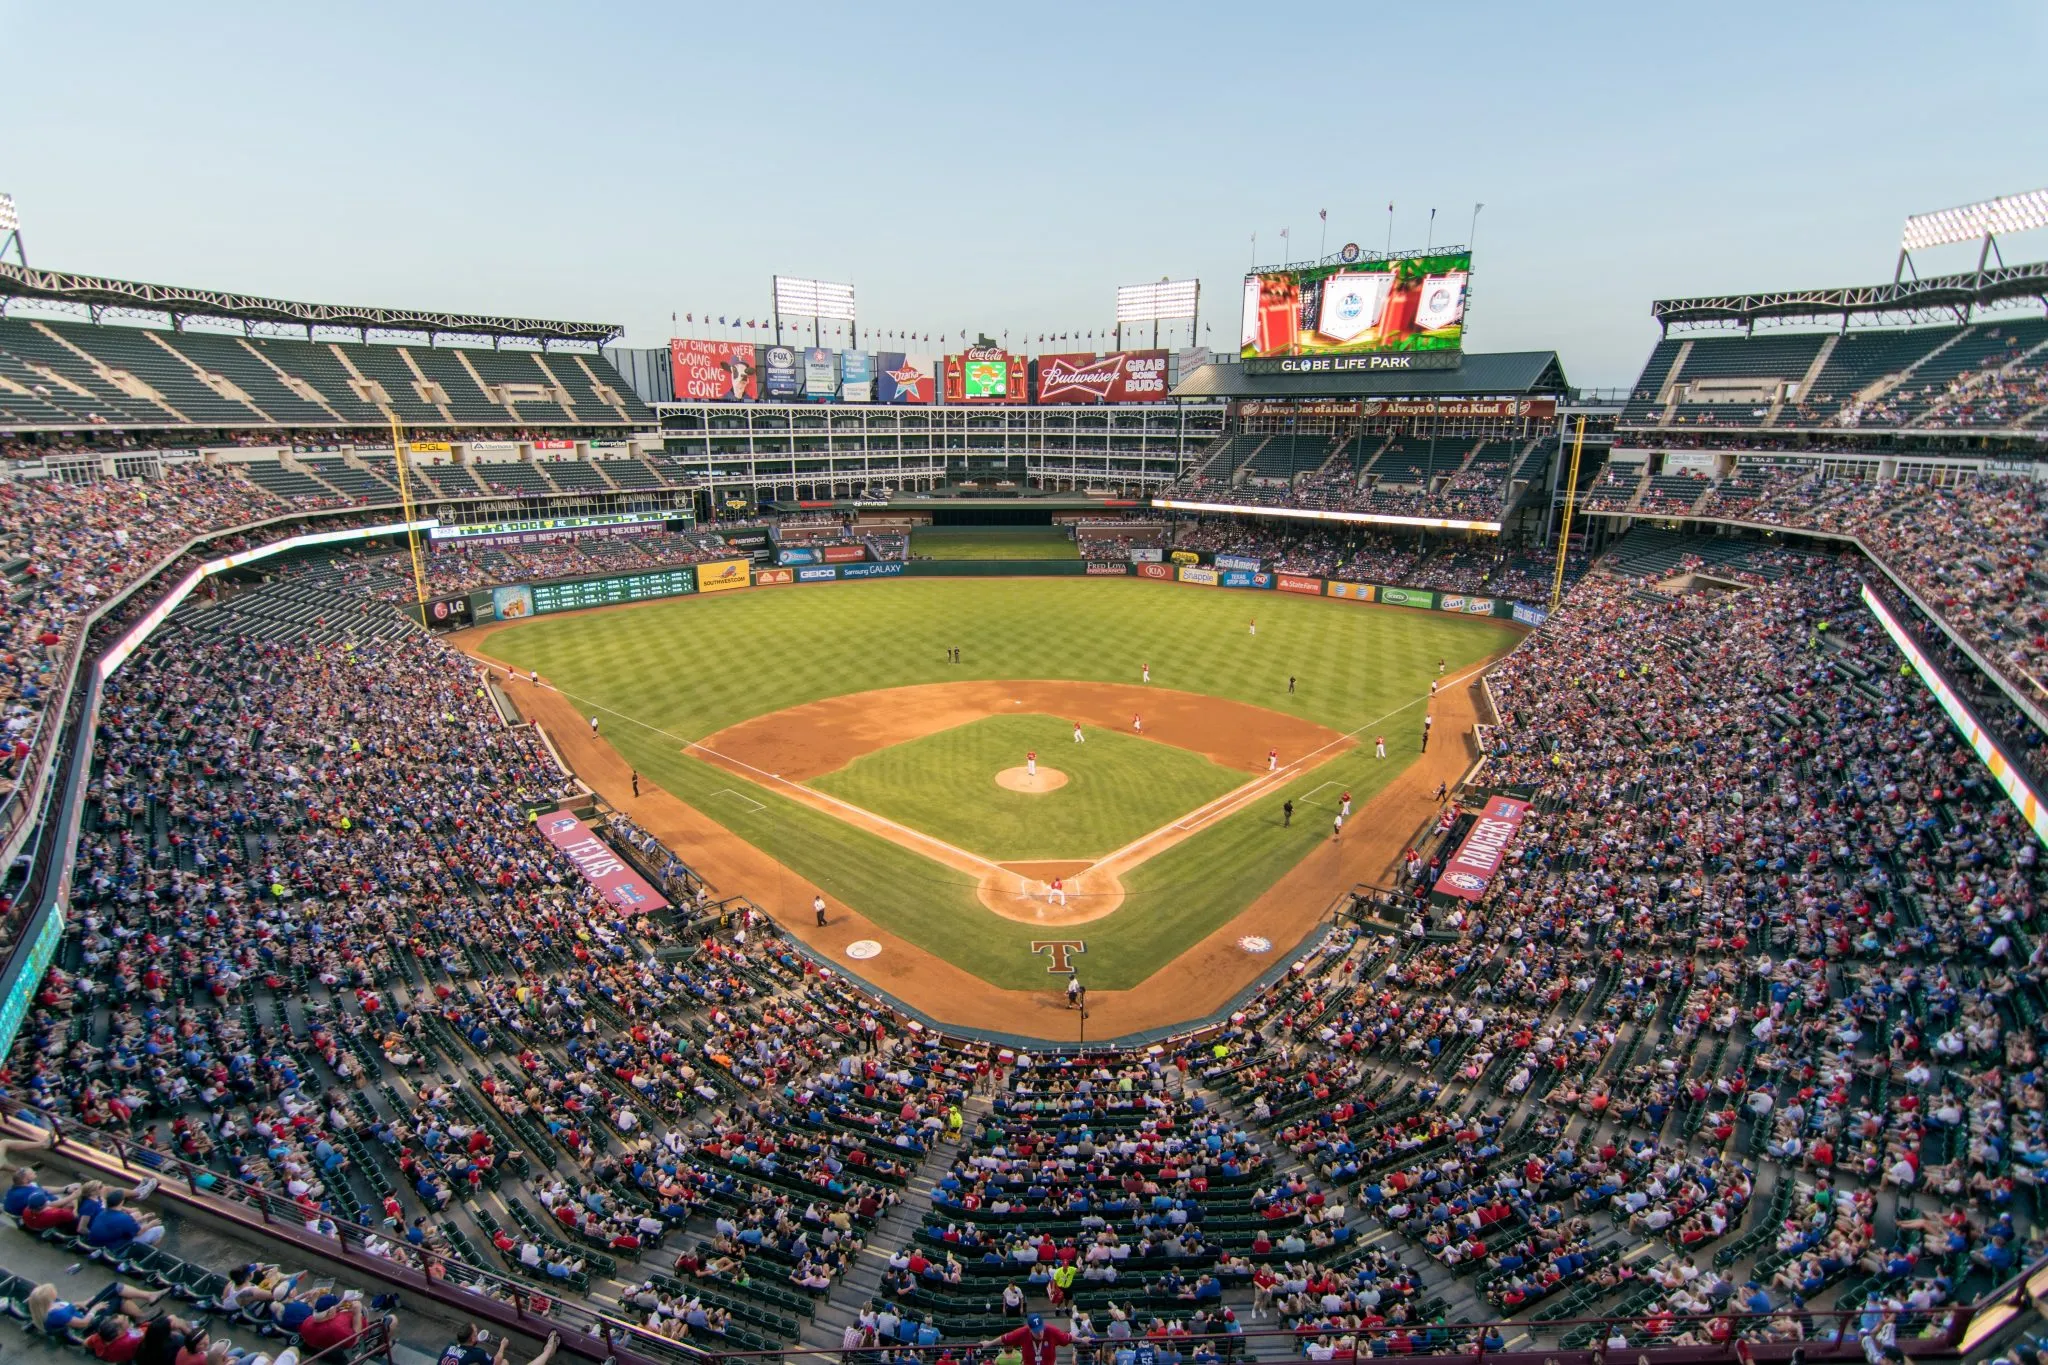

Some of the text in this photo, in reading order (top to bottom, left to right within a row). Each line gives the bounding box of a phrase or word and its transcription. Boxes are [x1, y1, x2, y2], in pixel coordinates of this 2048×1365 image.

[672, 340, 754, 356] EAT CHIKIN OR WEER
[678, 352, 710, 367] GOING
[773, 352, 788, 360] FOX
[968, 348, 1004, 360] Coca-Cola
[1125, 359, 1165, 372] GRAB
[1281, 356, 1410, 371] GLOBE LIFE PARK
[691, 366, 726, 382] GOING
[1042, 368, 1120, 386] Budweiser
[1131, 371, 1158, 380] SOME
[688, 380, 724, 398] GONE
[1125, 379, 1163, 392] BUDS
[1262, 404, 1294, 415] Always
[1315, 403, 1326, 413] of
[1332, 403, 1356, 413] Kind
[1386, 404, 1424, 414] Always
[1449, 403, 1461, 413] of
[1470, 403, 1499, 413] Kind
[551, 498, 568, 506] JACK
[618, 493, 633, 502] JACK
[477, 502, 496, 511] JACK
[612, 525, 641, 534] NEXEN
[496, 536, 520, 544] TIRE
[1215, 557, 1233, 568] Cash
[801, 570, 835, 578] GEICO
[869, 564, 900, 574] GALAXY
[1184, 570, 1214, 581] Snapple
[704, 577, 745, 586] SOUTHWEST.COM
[449, 601, 464, 613] LG
[1443, 599, 1464, 608] Gulf
[1470, 603, 1491, 612] Gulf
[1457, 818, 1513, 870] RANGERS
[564, 838, 624, 878] TEXAS
[1032, 940, 1084, 972] T
